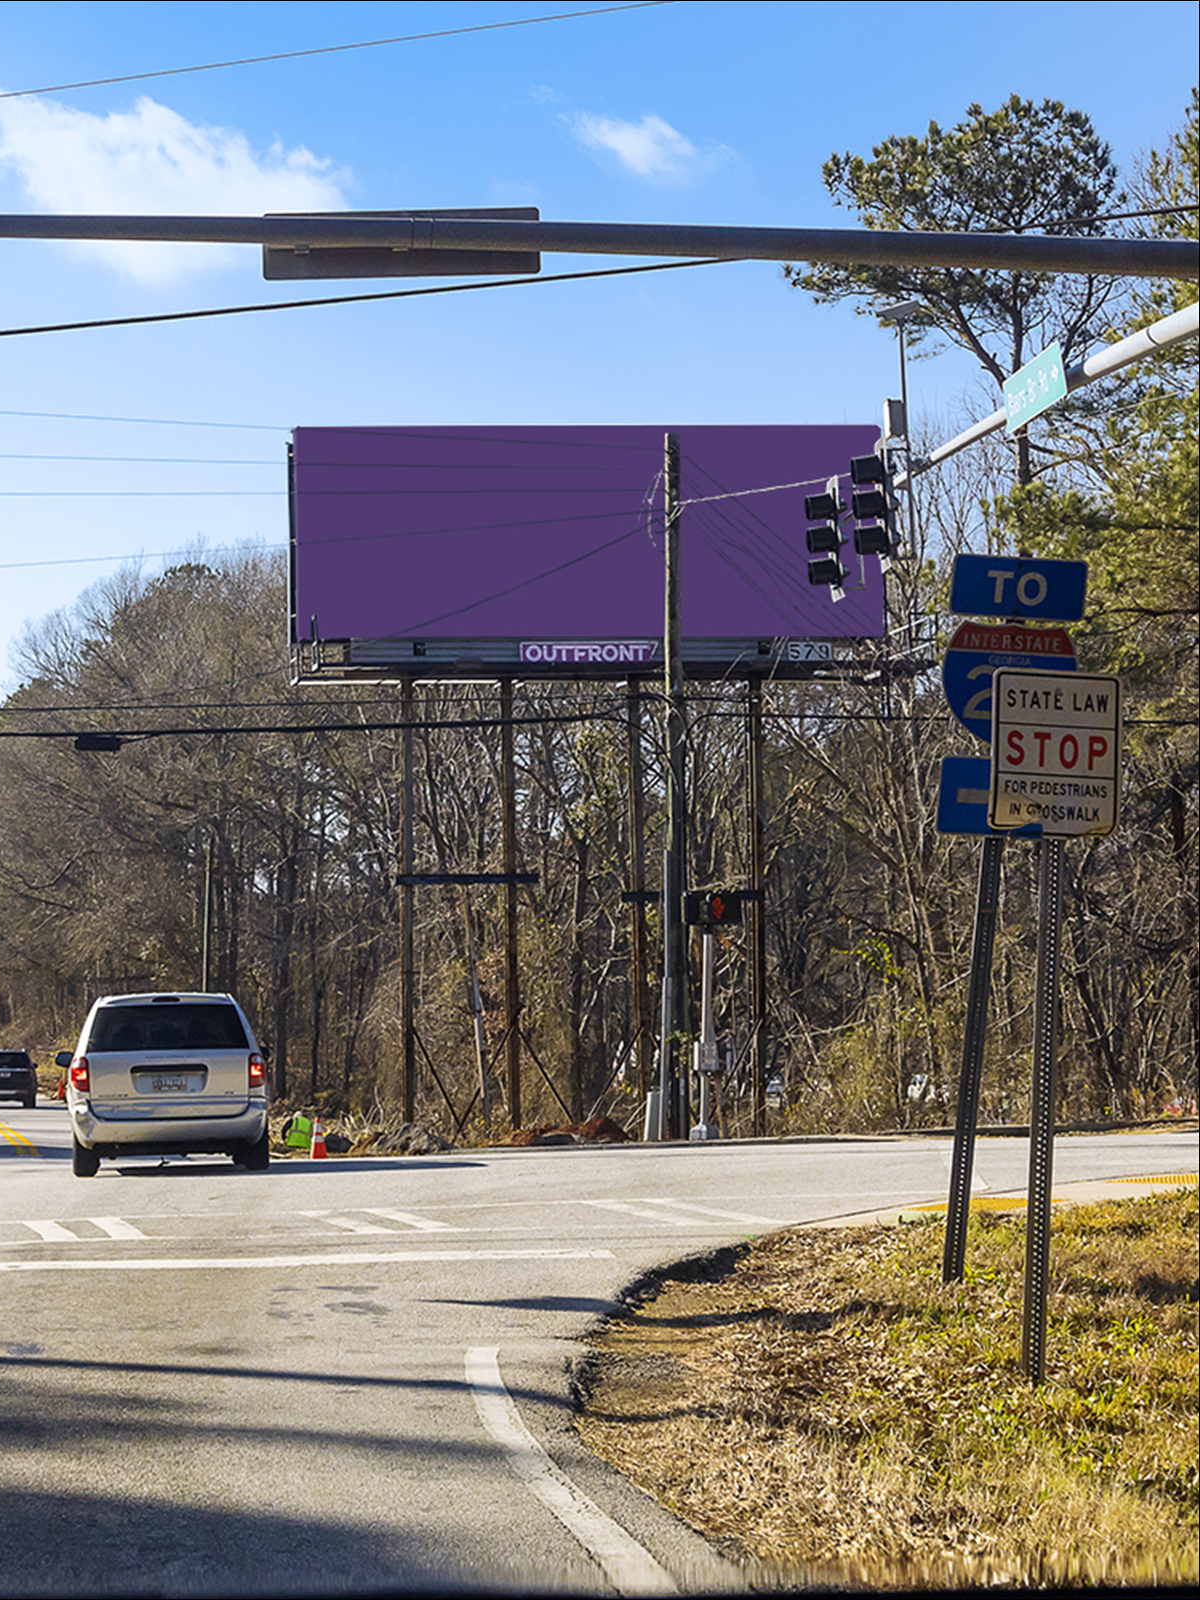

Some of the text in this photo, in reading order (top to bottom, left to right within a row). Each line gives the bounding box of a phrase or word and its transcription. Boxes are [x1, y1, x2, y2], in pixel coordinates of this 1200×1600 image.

[987, 570, 1048, 607] TO
[525, 644, 647, 662] OUTFRONT
[963, 632, 1062, 653] INTERSTATE
[988, 655, 1032, 667] GEORGIA
[962, 664, 994, 719] 2
[1006, 688, 1109, 713] STATE LAW
[1006, 730, 1108, 771] STOP
[1004, 779, 1108, 799] FOR PEDESTRIANS
[1009, 802, 1021, 816] IN
